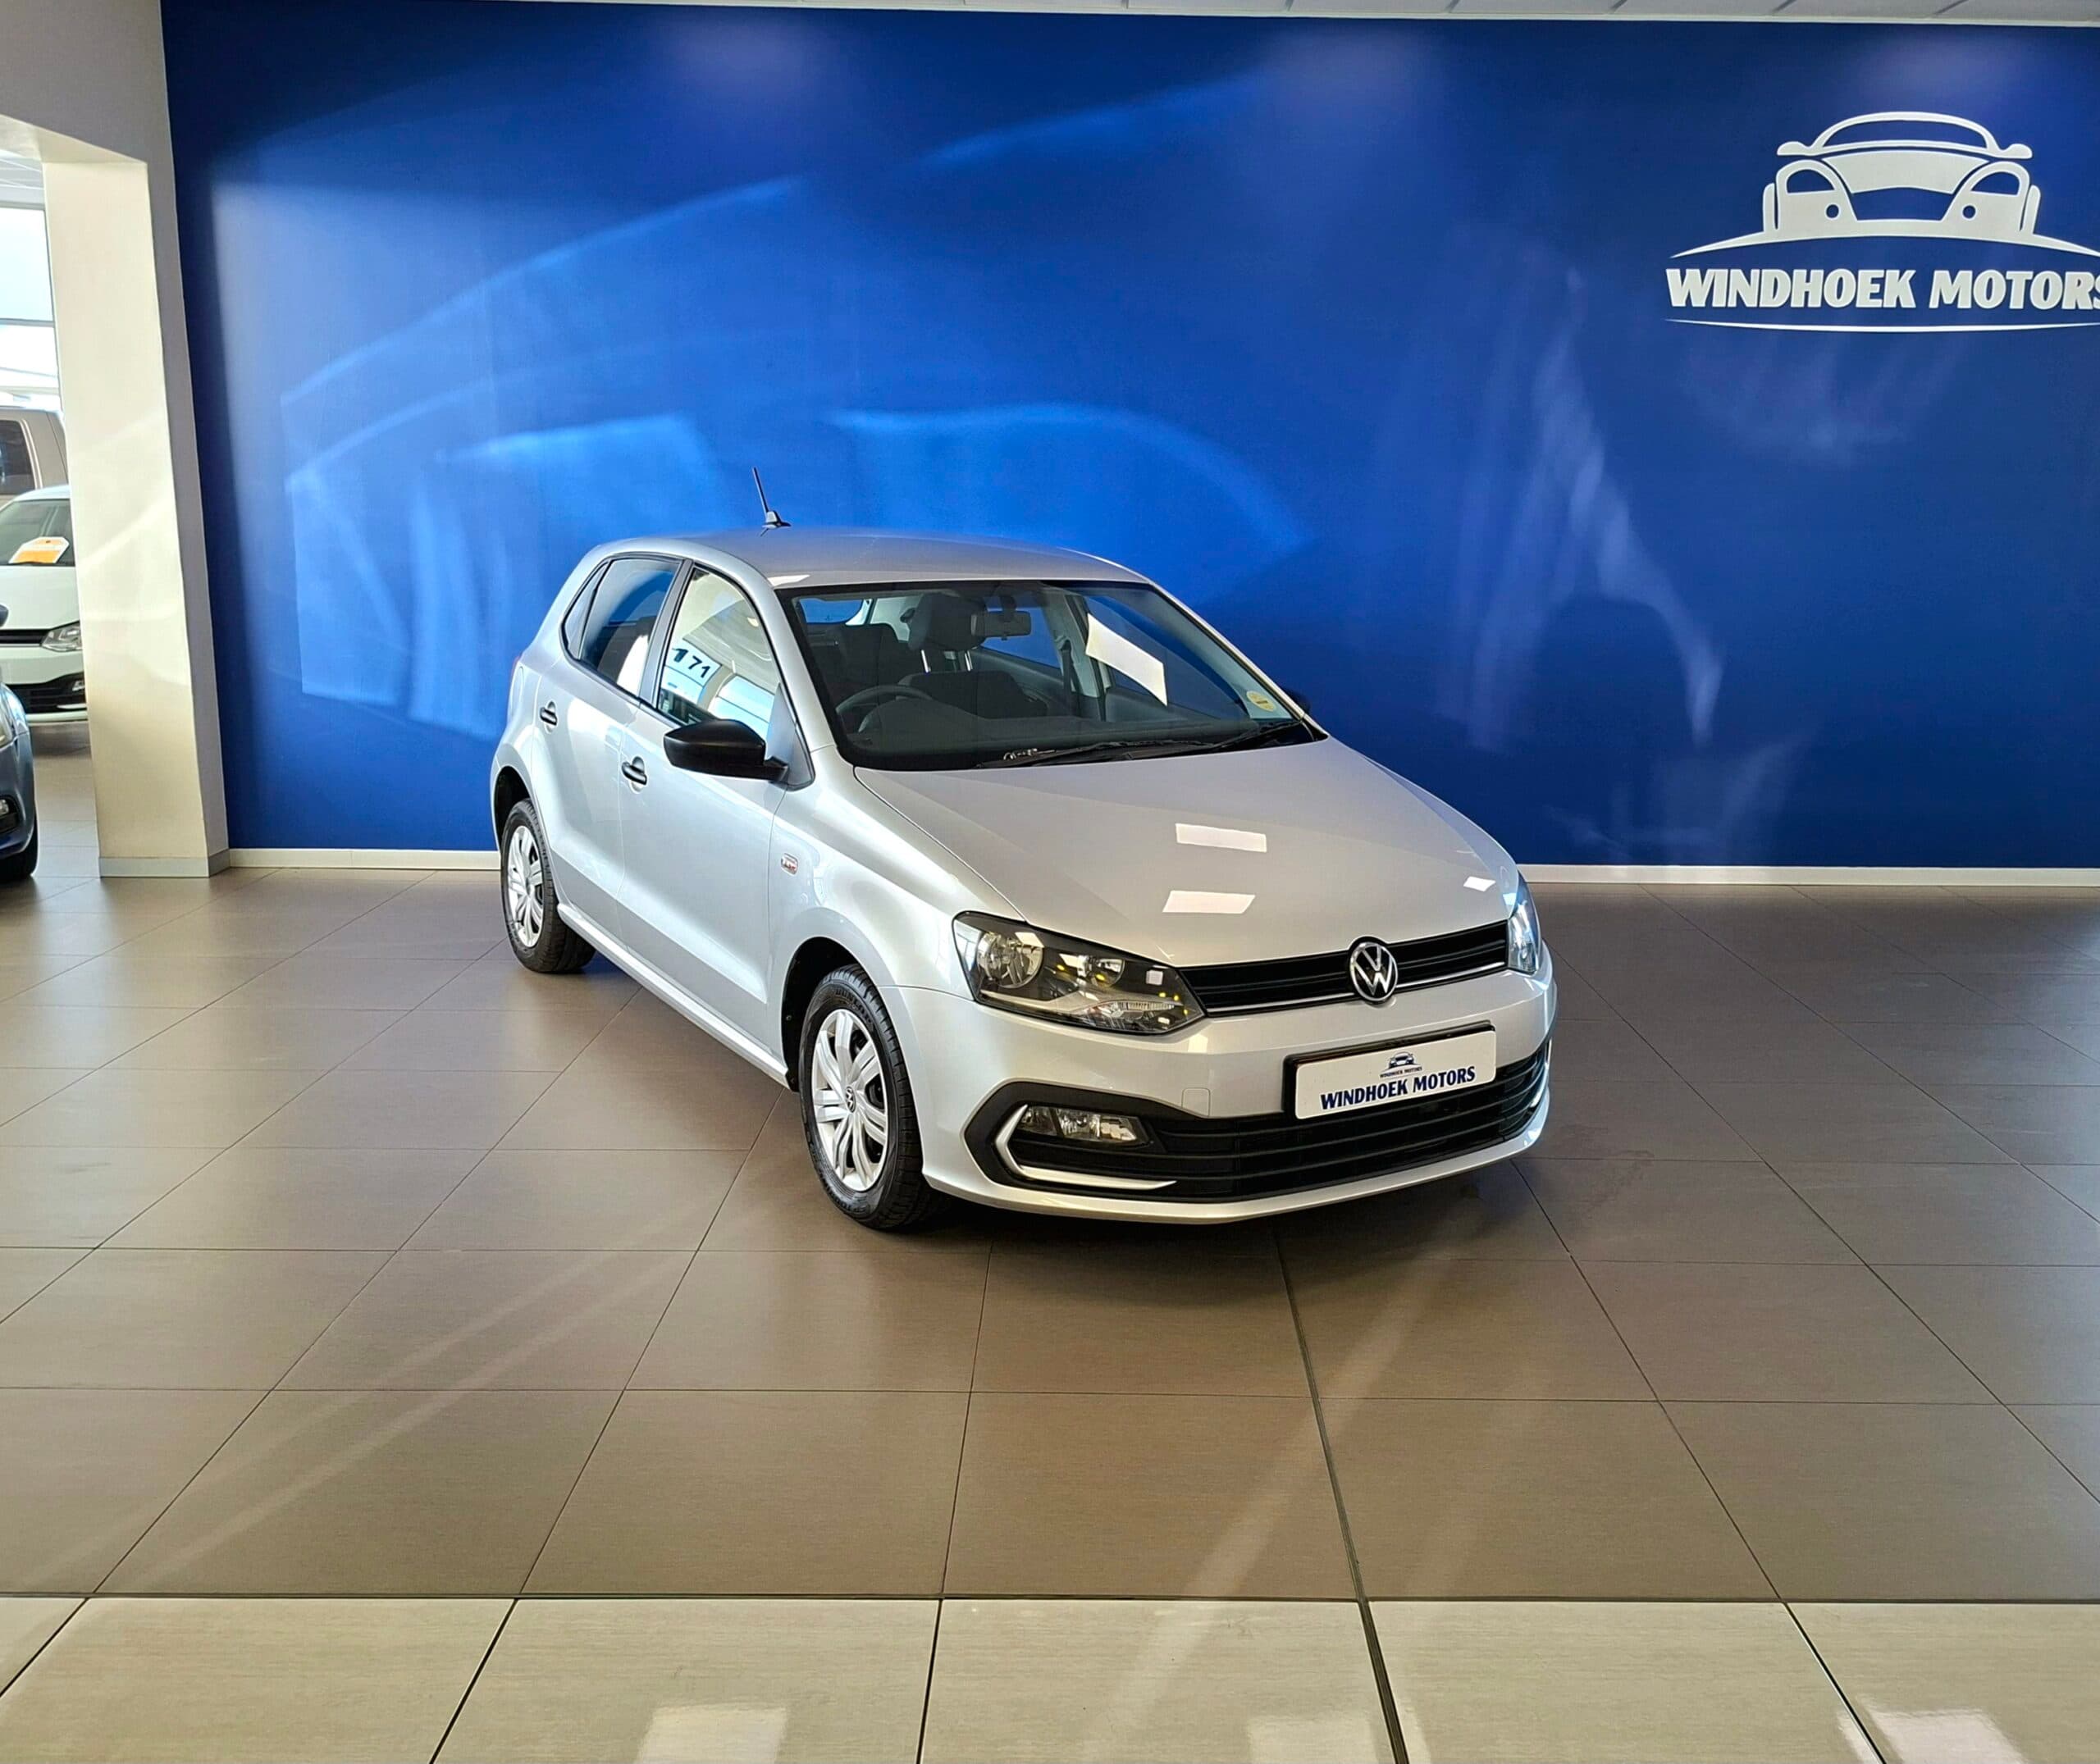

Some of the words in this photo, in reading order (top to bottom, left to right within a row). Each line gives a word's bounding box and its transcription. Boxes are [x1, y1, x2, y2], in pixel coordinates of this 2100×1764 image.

[1665, 268, 1916, 308] WINDHOEK
[1929, 270, 2100, 310] MOTOR
[1349, 941, 1398, 1001] VW
[1321, 1079, 1408, 1110] WINDHOEK
[1413, 1065, 1476, 1094] MOTORS
